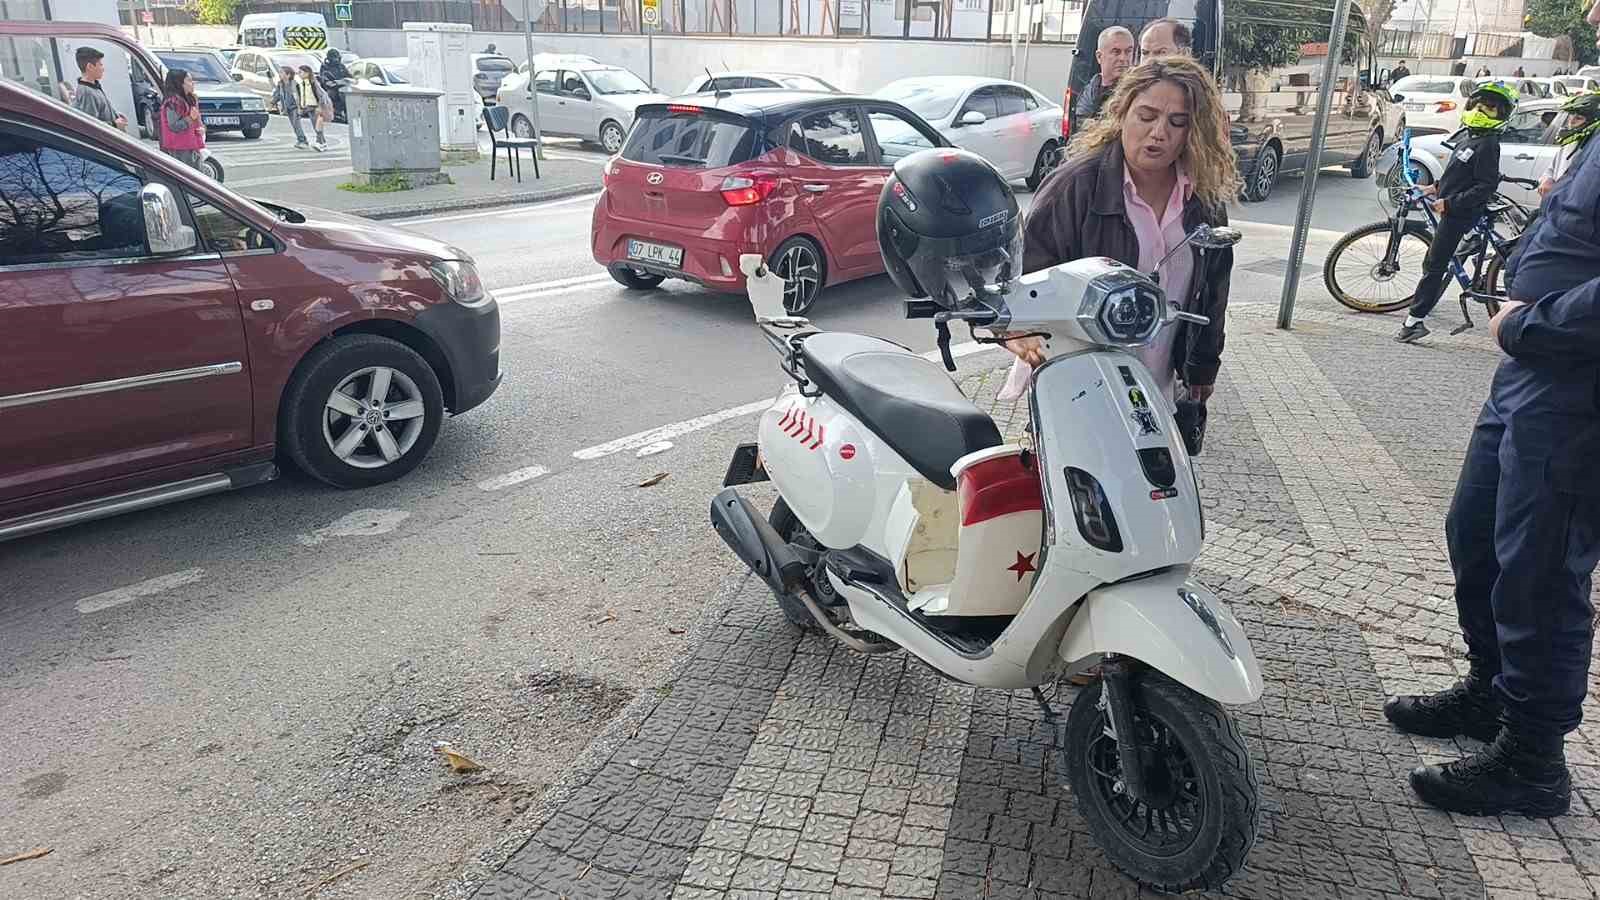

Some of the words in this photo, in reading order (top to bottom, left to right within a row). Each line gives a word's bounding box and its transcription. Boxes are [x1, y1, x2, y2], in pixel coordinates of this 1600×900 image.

[632, 242, 644, 255] 07
[648, 245, 664, 260] LPK
[669, 249, 680, 262] 44
